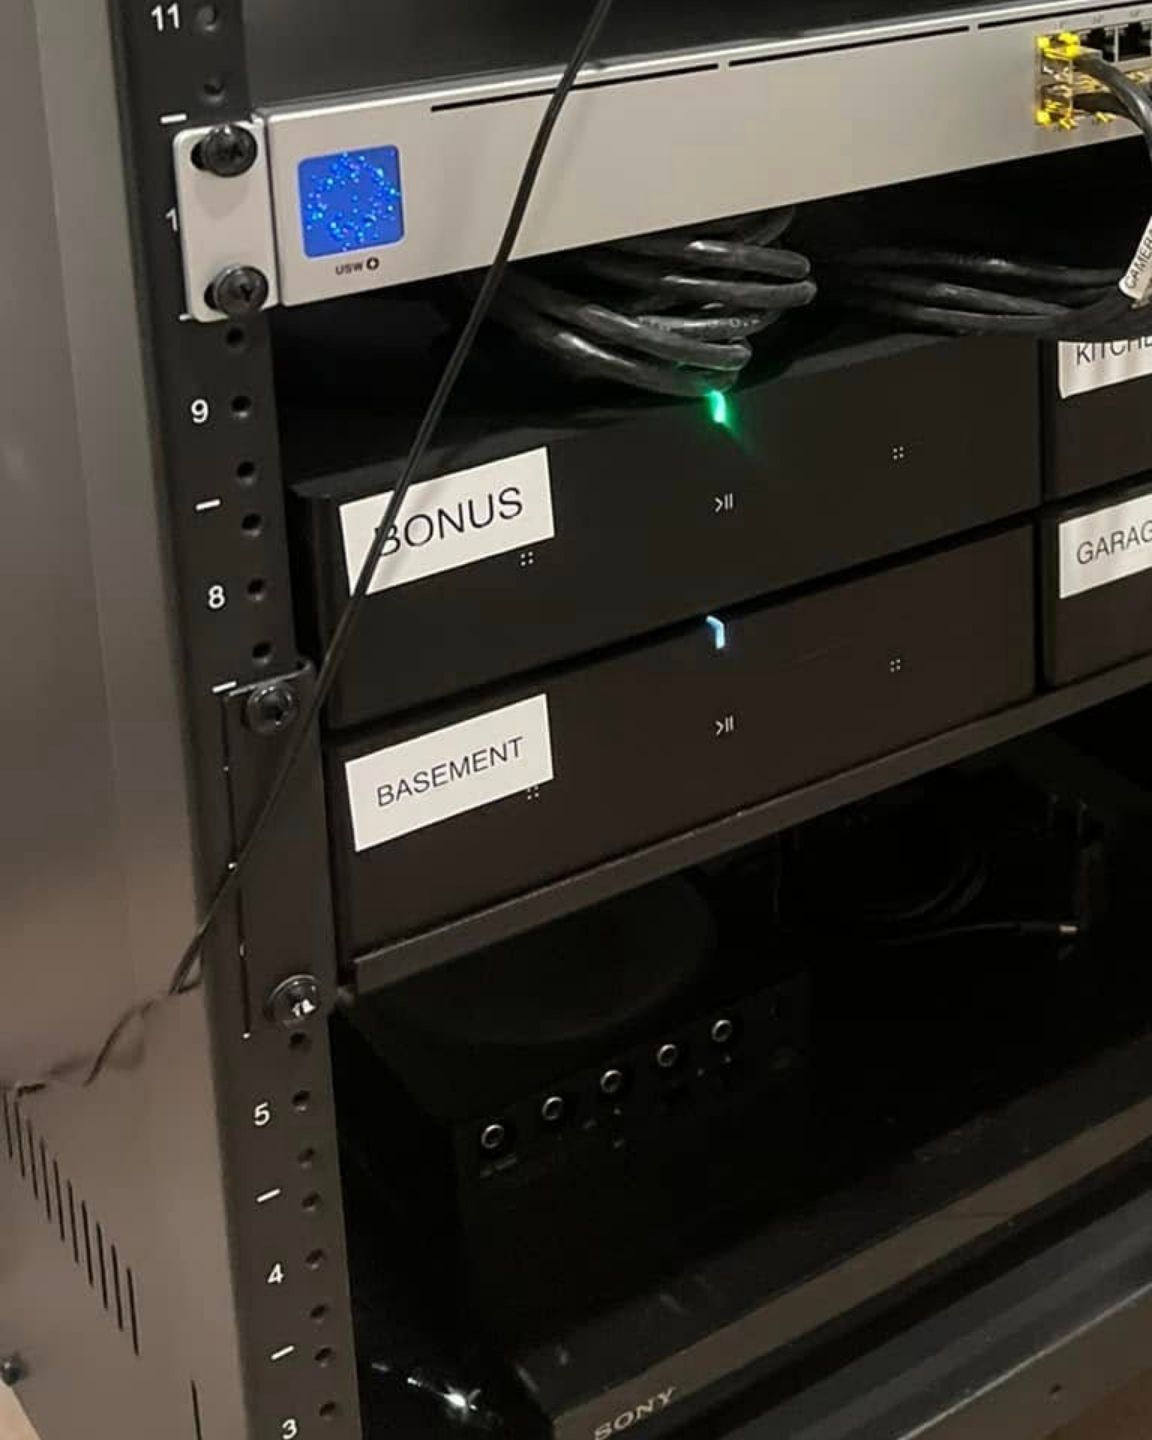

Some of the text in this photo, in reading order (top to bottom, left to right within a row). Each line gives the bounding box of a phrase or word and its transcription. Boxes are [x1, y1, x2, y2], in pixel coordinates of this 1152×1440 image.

[150, 3, 181, 31] 11
[335, 263, 363, 275] USW
[191, 399, 209, 424] 9
[374, 486, 524, 557] BONUS
[207, 586, 226, 609] 8
[375, 737, 524, 807] BASEMENT
[254, 1101, 270, 1127] 5
[267, 1264, 284, 1286] 4
[594, 1386, 676, 1440] SONY
[282, 1418, 298, 1439] 3
